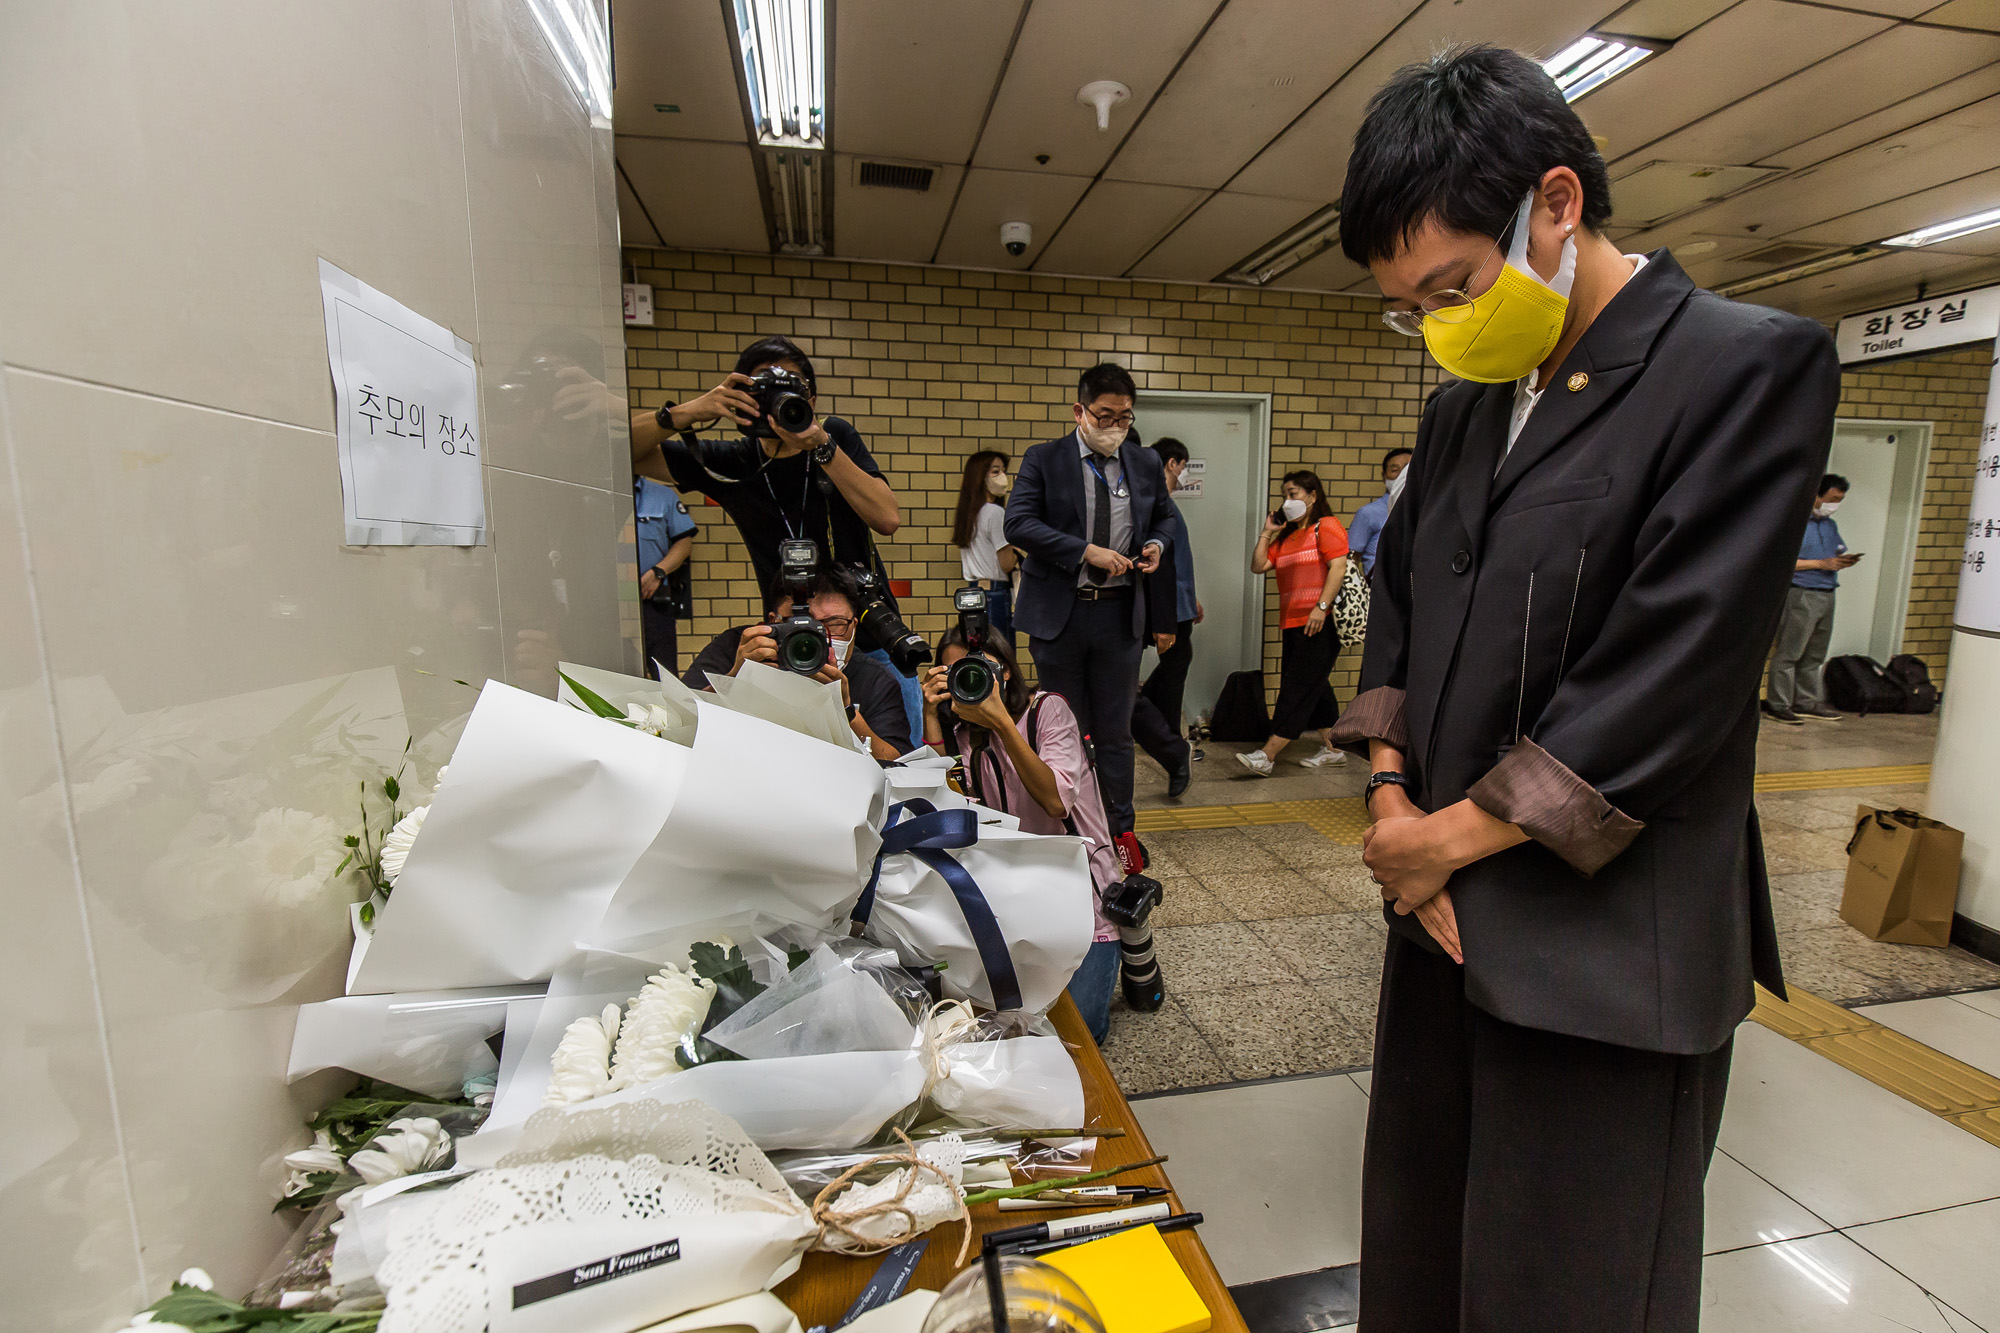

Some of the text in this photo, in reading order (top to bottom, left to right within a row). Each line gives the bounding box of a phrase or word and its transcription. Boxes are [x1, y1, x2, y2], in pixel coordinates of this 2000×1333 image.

[1863, 299, 1968, 337] 화장실
[1862, 337, 1904, 354] Toilet
[358, 384, 476, 456] 추모의 장소
[573, 1265, 605, 1284] San
[608, 1242, 678, 1273] Francisco
